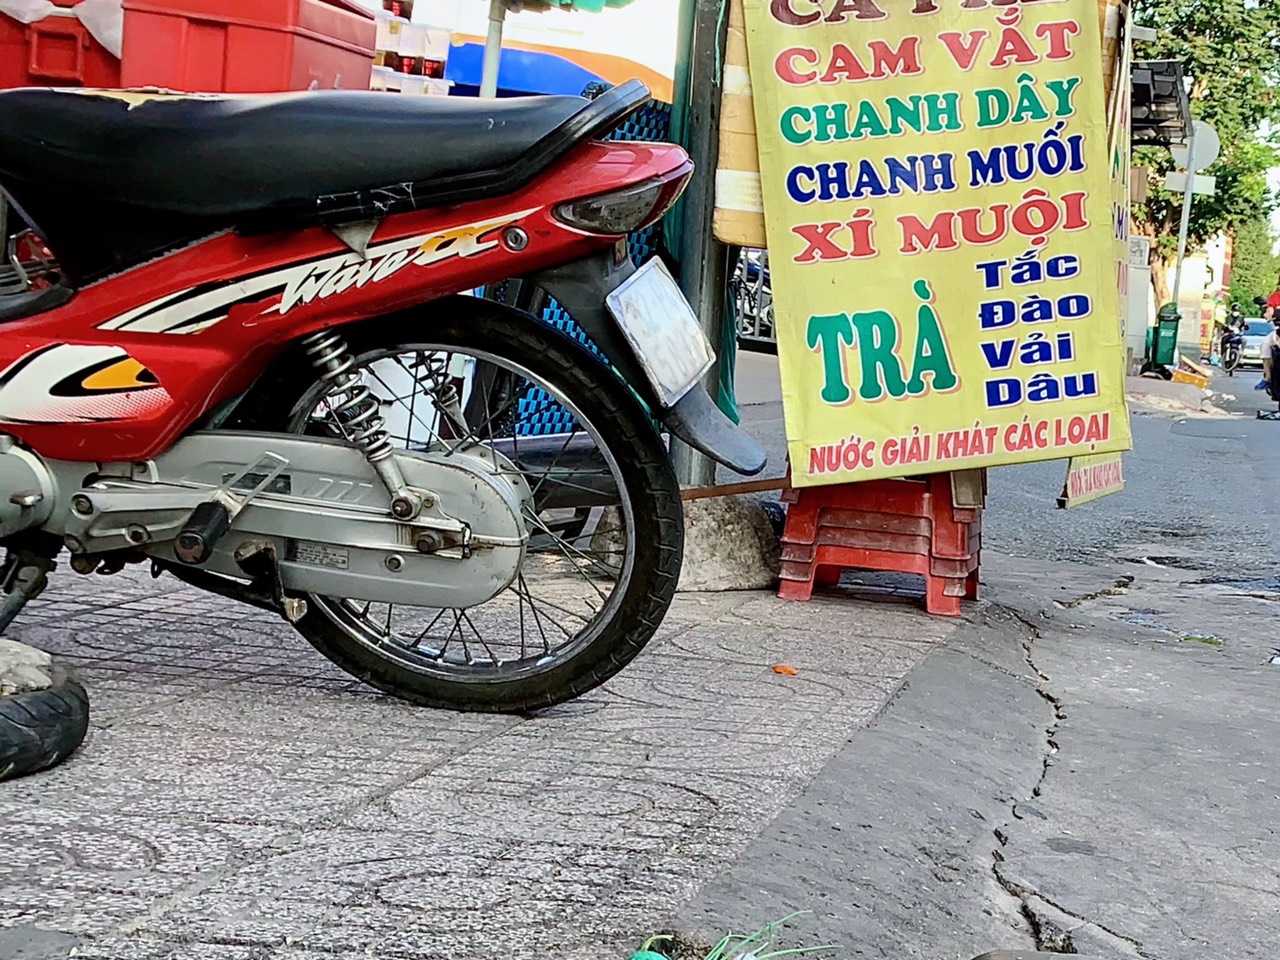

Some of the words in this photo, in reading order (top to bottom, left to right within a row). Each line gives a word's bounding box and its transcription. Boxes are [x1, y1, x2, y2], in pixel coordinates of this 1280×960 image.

[775, 36, 922, 84] CAM
[938, 7, 1079, 69] VẮT
[780, 92, 961, 143] CHANH
[975, 73, 1079, 127] DÂY
[786, 153, 955, 203] CHANH
[968, 122, 1085, 187] MUỐI
[792, 209, 877, 262] XÍ
[897, 189, 1088, 252] MUỘI
[280, 248, 410, 315] Wave
[977, 249, 1080, 288] Tắc
[807, 279, 958, 403] TRÀ
[978, 294, 1091, 329] Đào
[981, 332, 1073, 369] Vải
[986, 373, 1097, 408] Dâu
[808, 435, 876, 474] NƯỚC
[881, 425, 930, 466] GIẢI
[937, 420, 999, 460] KHÁT
[1004, 414, 1048, 452] CÁC
[1055, 412, 1110, 452] LOẠI
